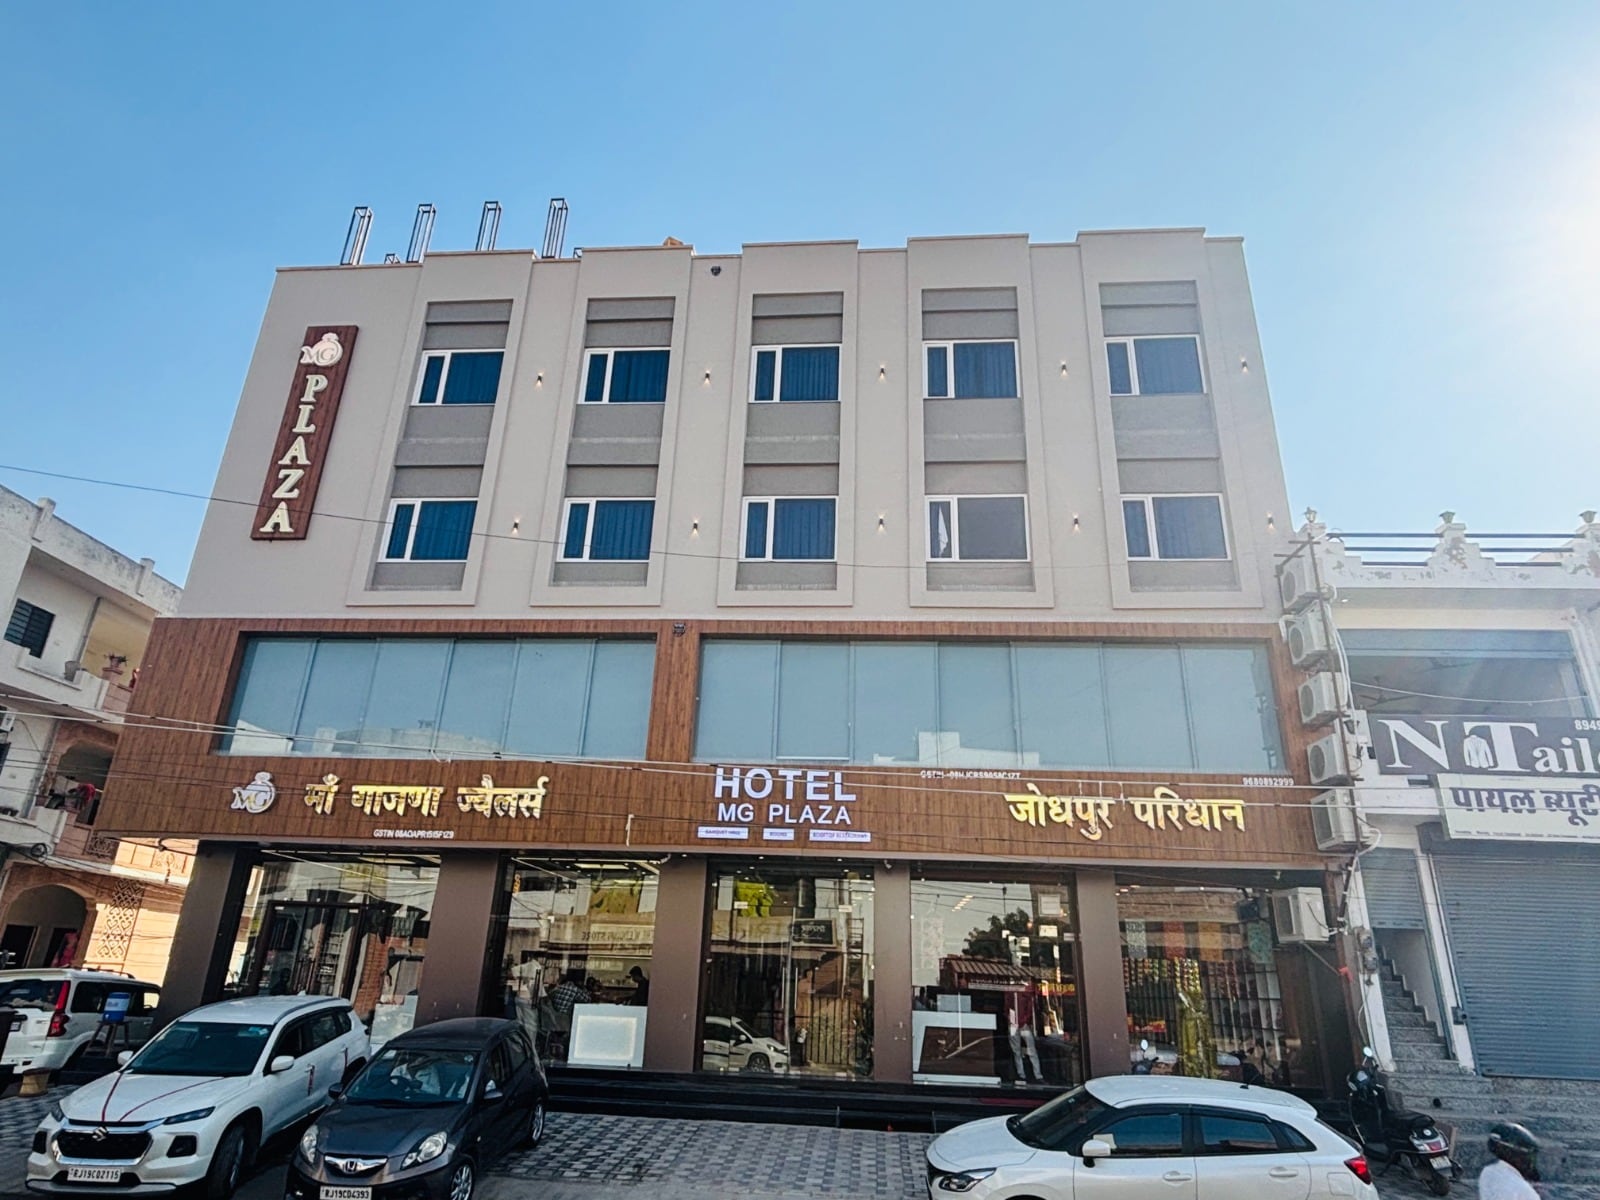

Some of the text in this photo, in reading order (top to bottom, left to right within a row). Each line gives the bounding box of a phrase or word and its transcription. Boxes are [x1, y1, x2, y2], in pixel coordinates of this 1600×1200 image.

[259, 373, 329, 533] PLAZA
[1463, 720, 1600, 774] Tail
[714, 767, 857, 802] HOTEL
[1449, 786, 1537, 815] पायल
[717, 803, 852, 826] MG PLAZA
[1003, 782, 1246, 841] जोधपुर परिधान
[373, 828, 394, 838] GSTIN
